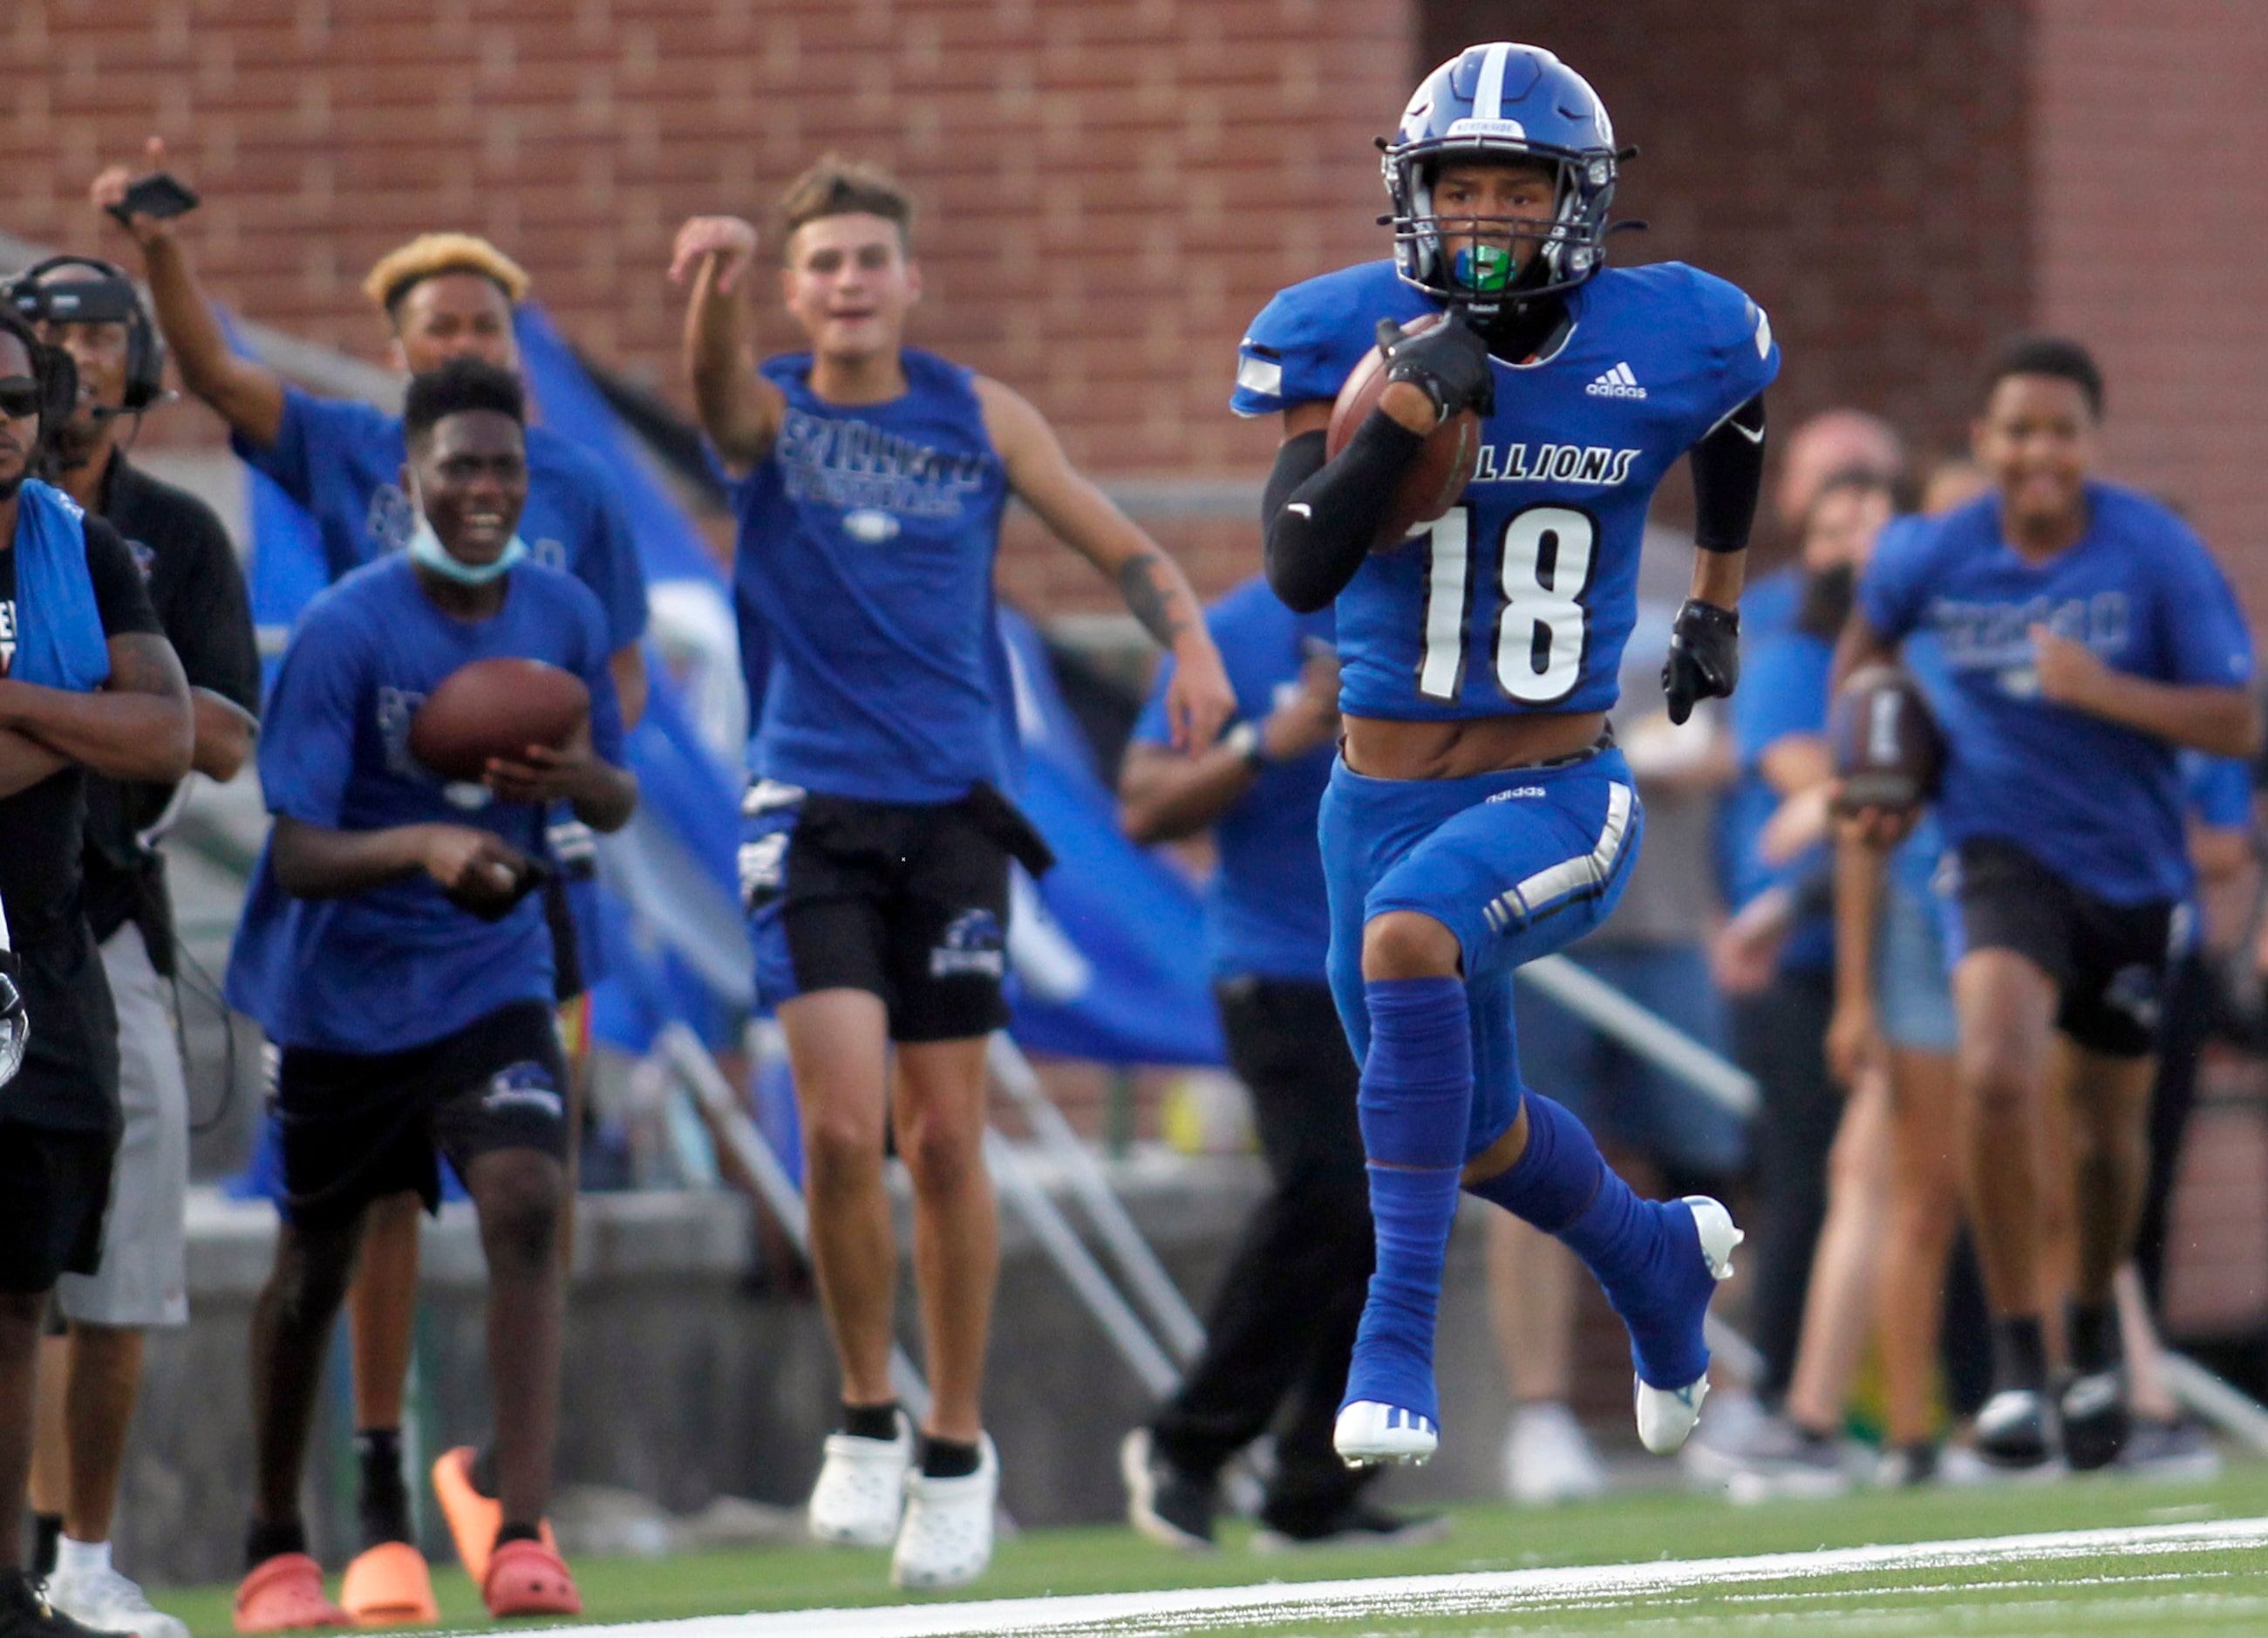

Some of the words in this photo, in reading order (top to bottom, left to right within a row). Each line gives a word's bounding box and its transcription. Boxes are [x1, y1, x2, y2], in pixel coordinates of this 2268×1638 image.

[1585, 383, 1648, 399] adidas
[1469, 443, 1643, 486] LLIONS
[1404, 504, 1595, 703] 18
